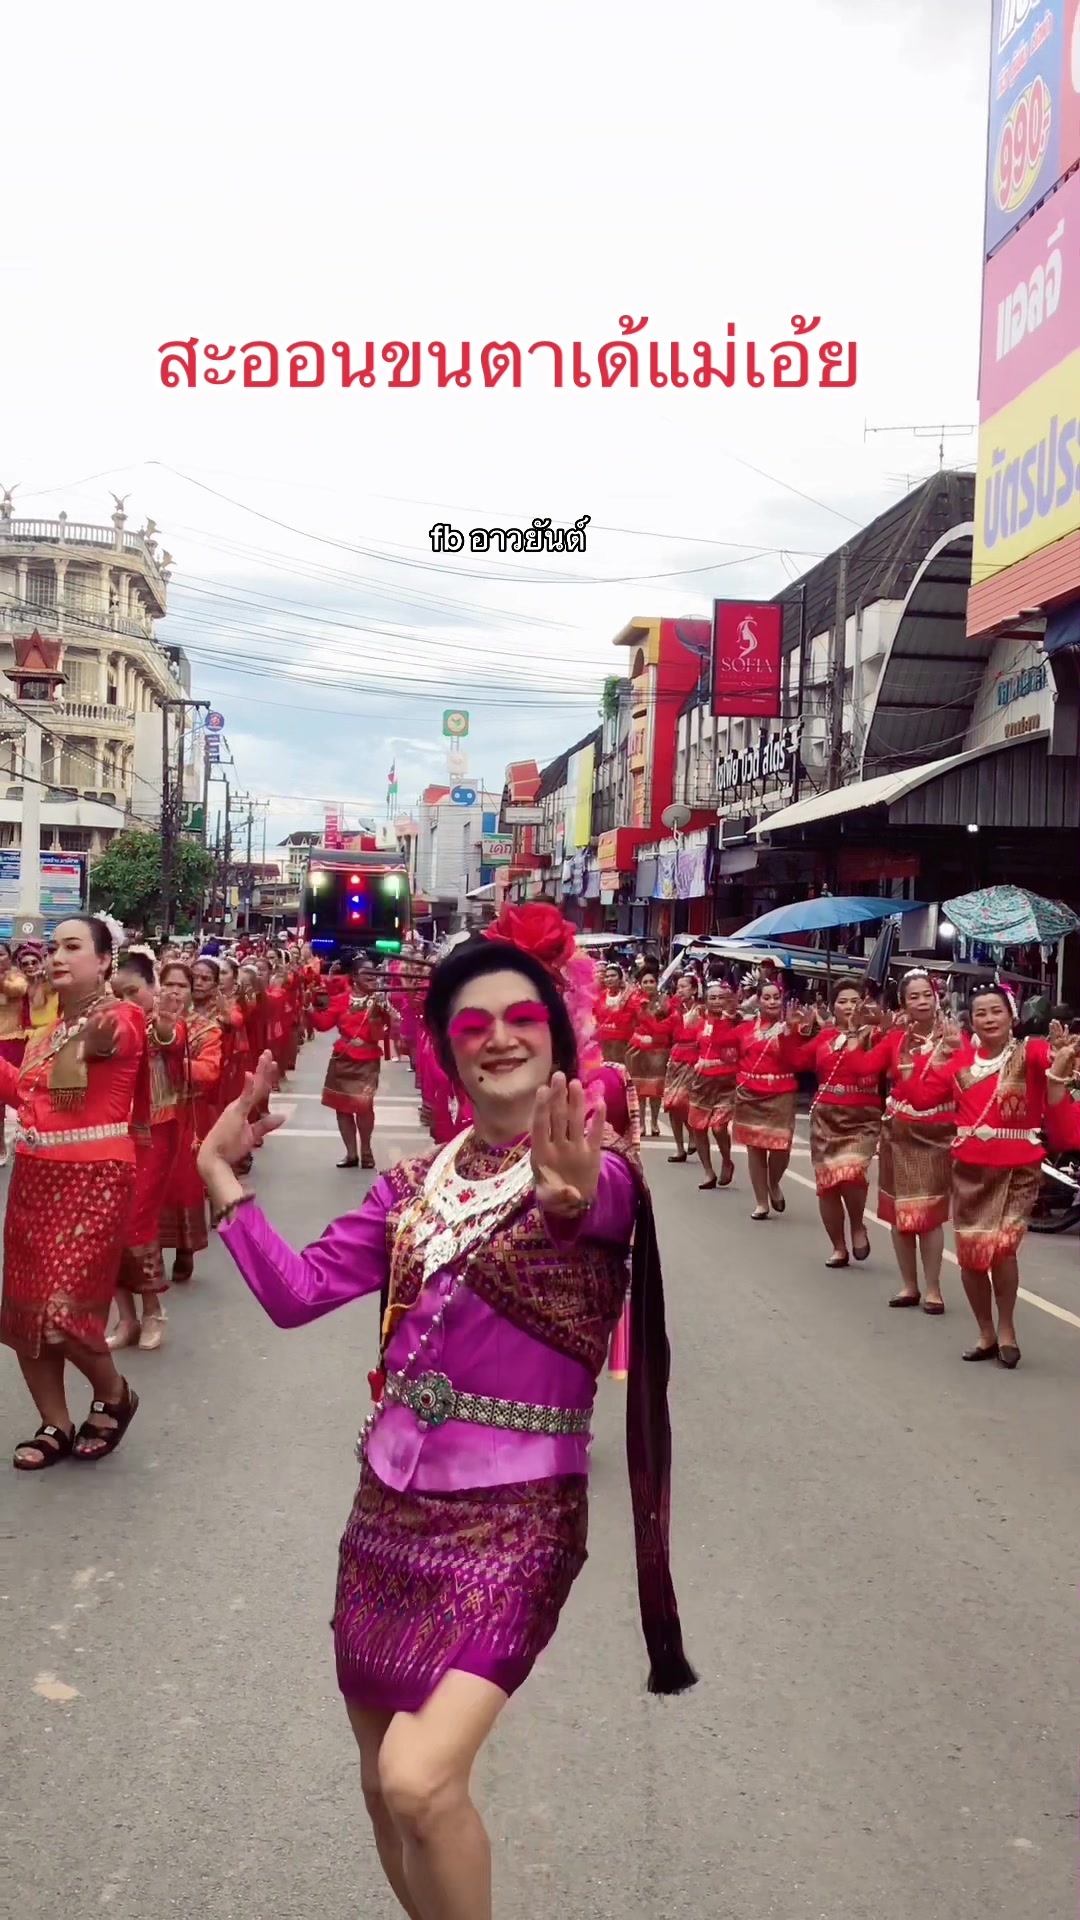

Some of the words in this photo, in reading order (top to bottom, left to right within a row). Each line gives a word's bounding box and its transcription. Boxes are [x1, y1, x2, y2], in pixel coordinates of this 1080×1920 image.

[996, 218, 1064, 362] แอลจี
[983, 414, 1080, 549] บัตรปร
[721, 656, 773, 673] SOFIA
